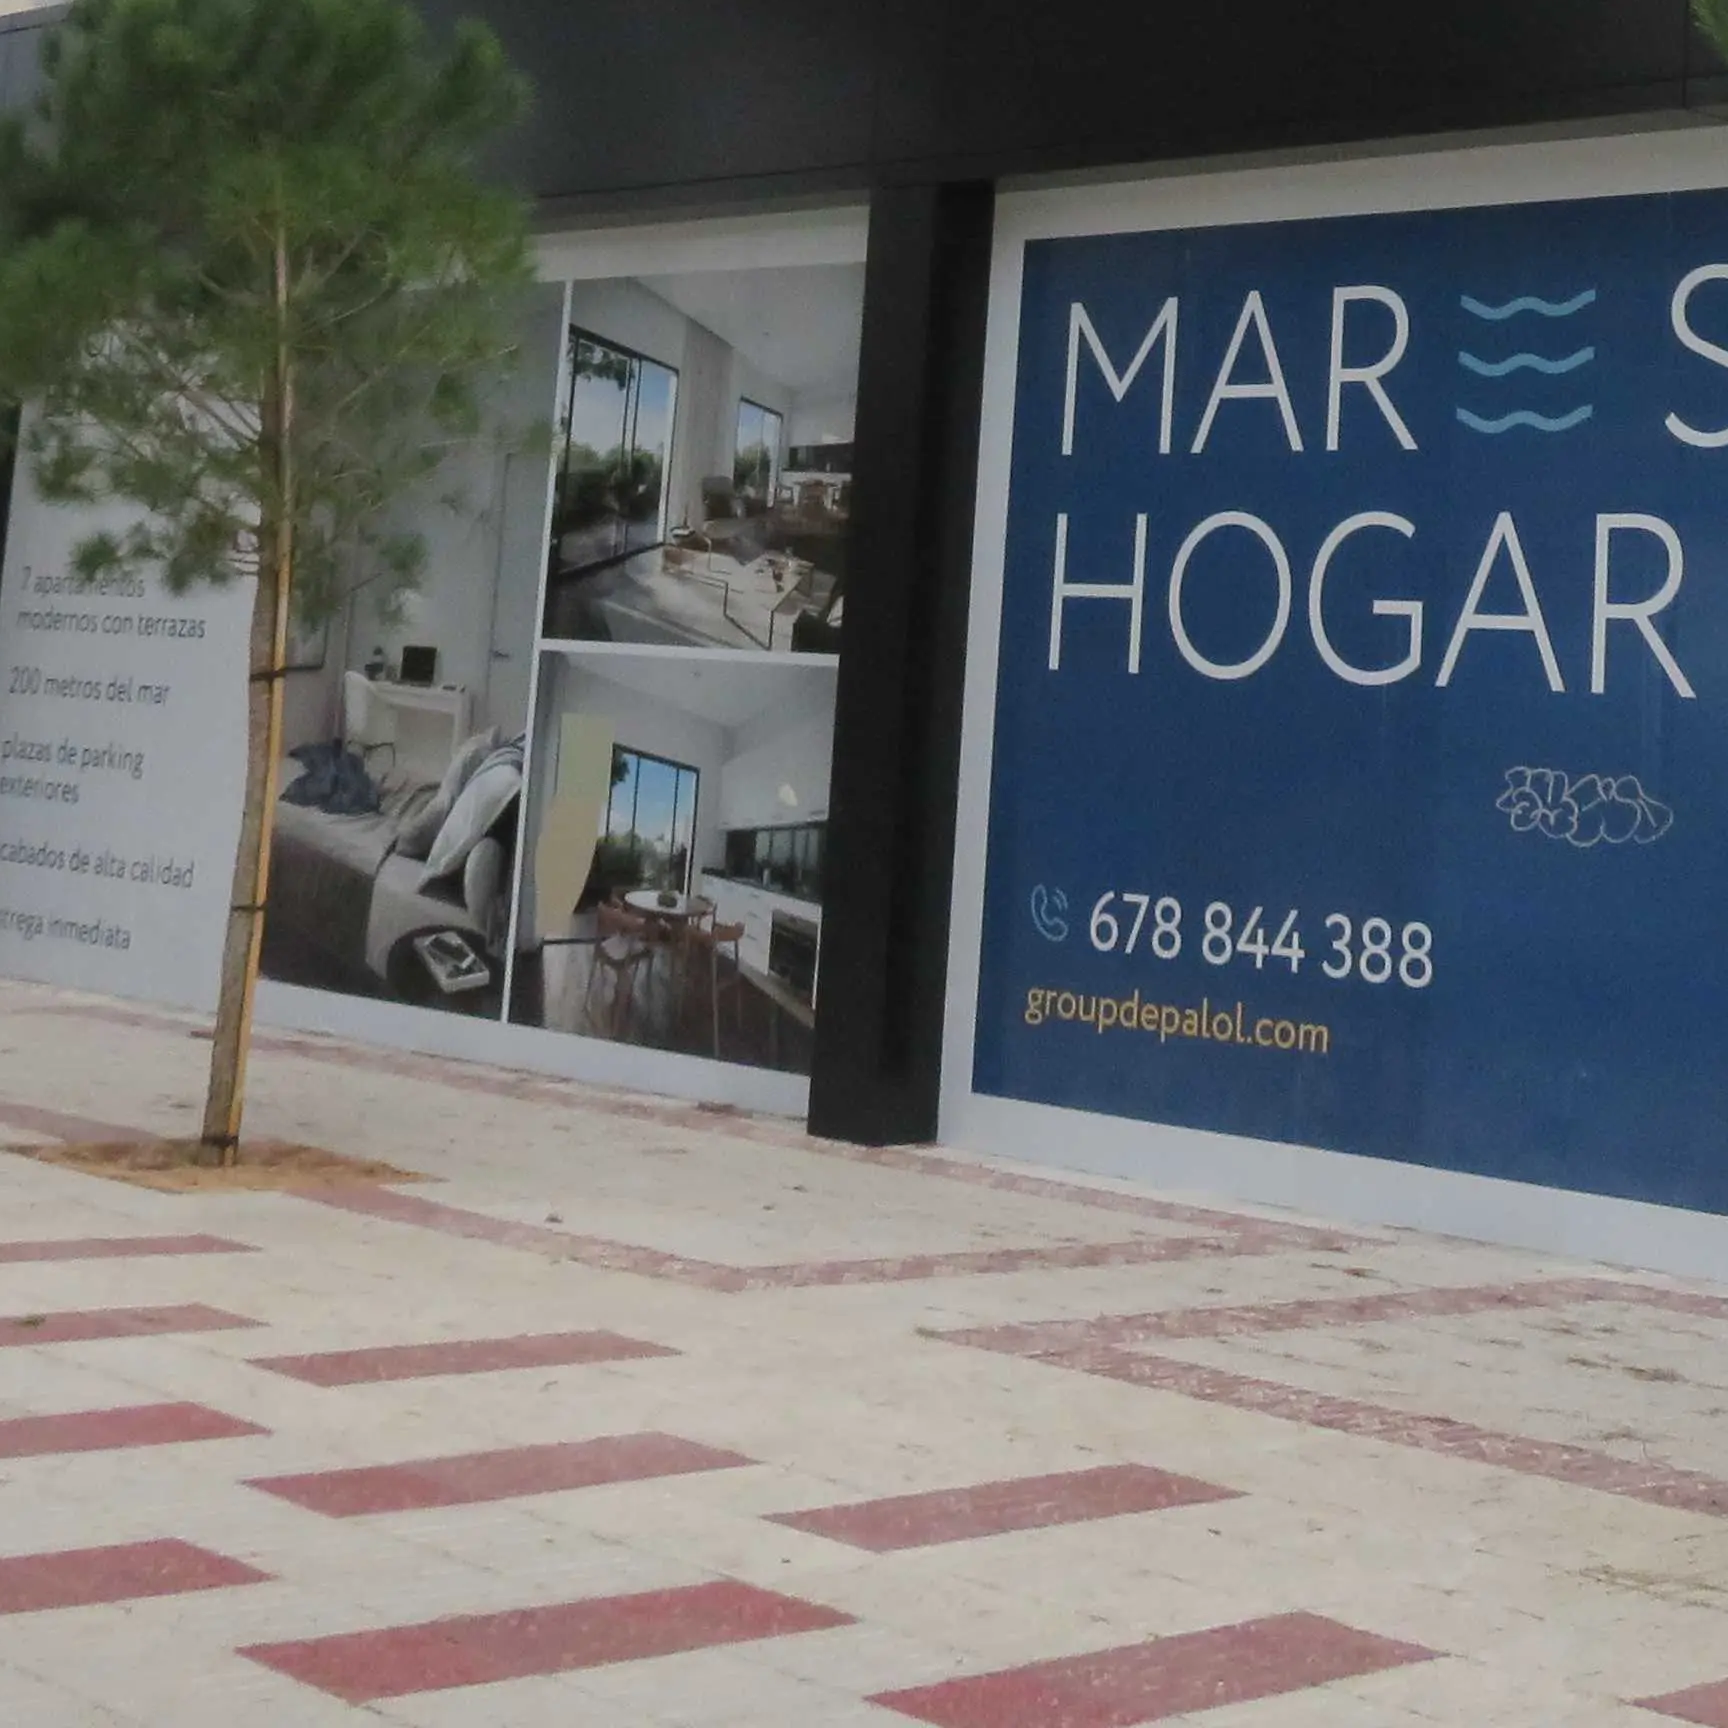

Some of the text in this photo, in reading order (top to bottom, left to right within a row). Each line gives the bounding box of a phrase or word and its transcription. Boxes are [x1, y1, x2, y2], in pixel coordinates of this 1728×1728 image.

[1062, 284, 1419, 456] MAR
[16, 606, 207, 639] modernos con terrazas
[1047, 509, 1697, 699] HOGAR
[8, 665, 171, 705] 200 metros del mar
[0, 732, 145, 781] plazas de parking
[68, 847, 90, 873] de
[93, 850, 126, 880] alta
[129, 853, 195, 889] calidad
[47, 912, 132, 951] inmediata
[1088, 890, 1435, 988] 678 844 388
[1023, 983, 1330, 1055] groupdepalol.com
